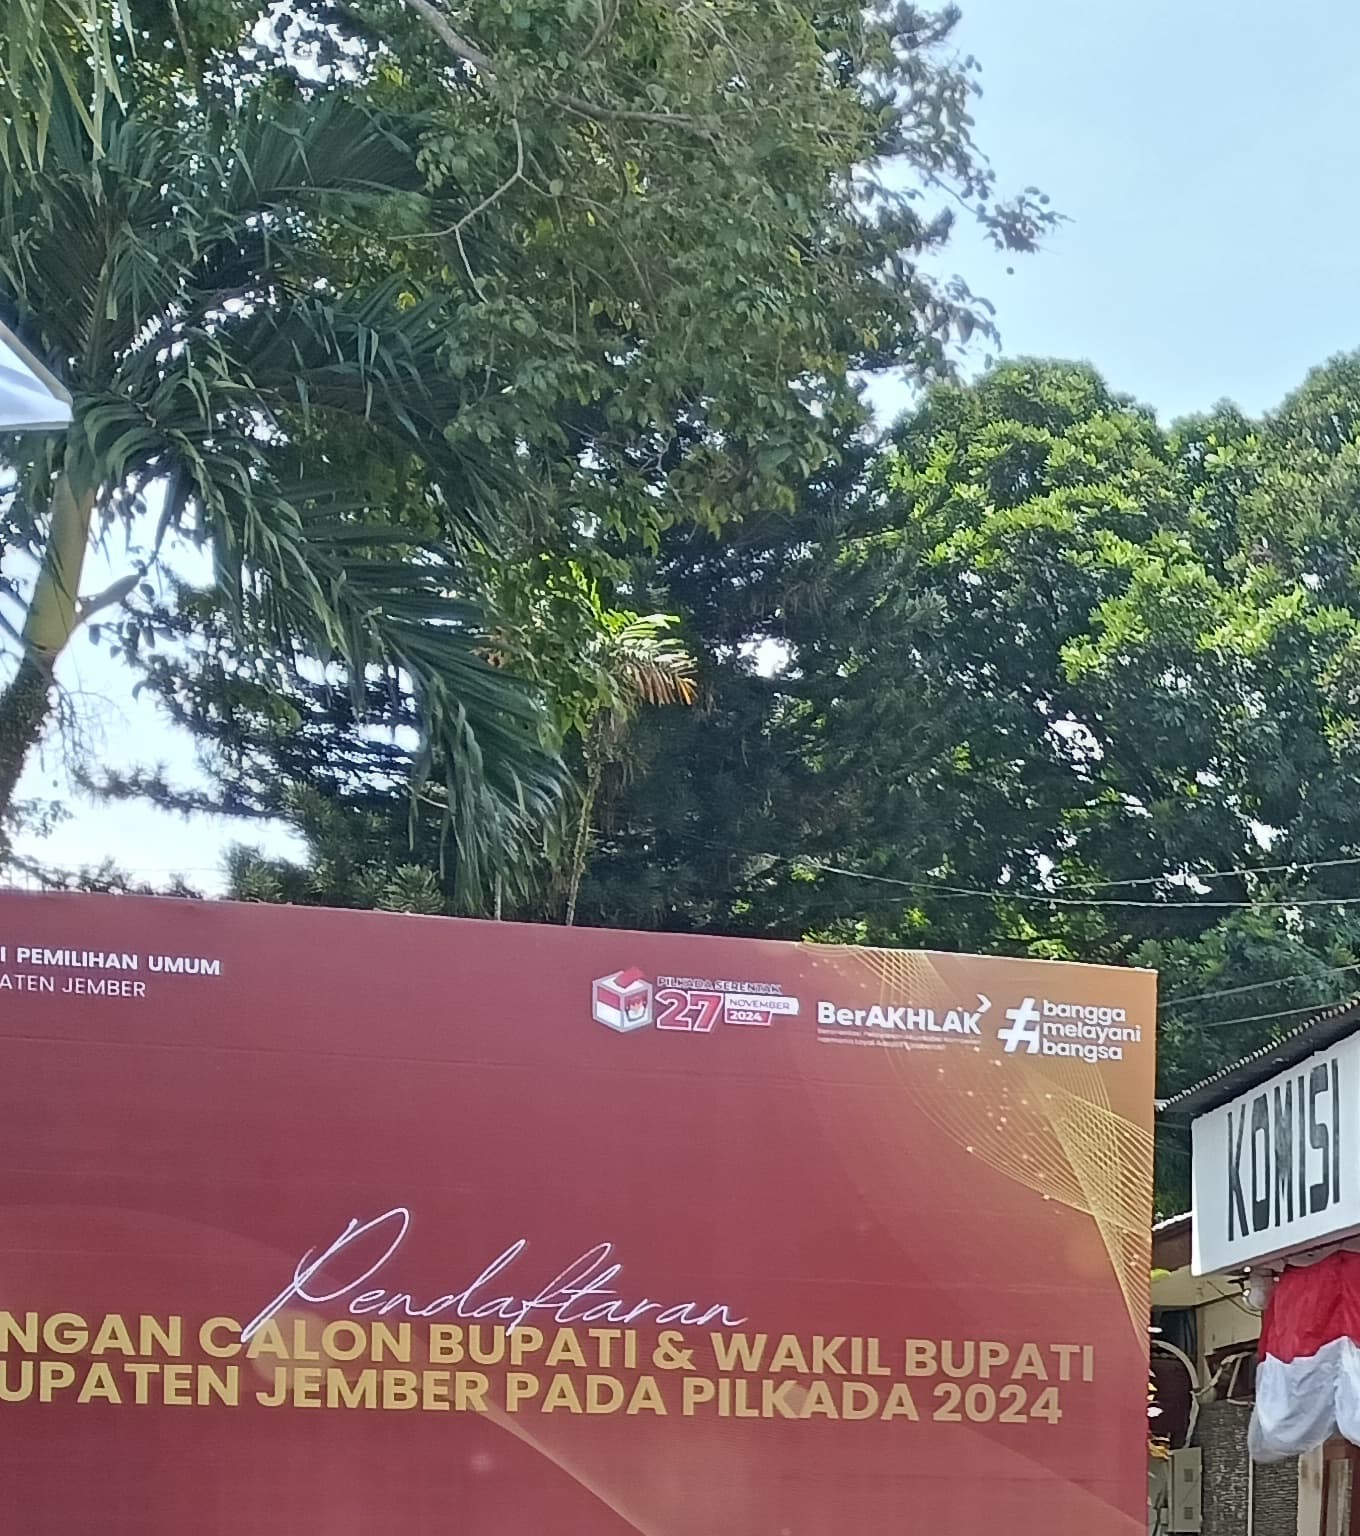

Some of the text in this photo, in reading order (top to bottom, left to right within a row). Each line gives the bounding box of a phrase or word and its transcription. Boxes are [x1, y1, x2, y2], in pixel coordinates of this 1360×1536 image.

[16, 946, 139, 971] PEMILIHAN
[148, 955, 221, 976] UMUM
[62, 978, 146, 998] JEMBER
[657, 976, 782, 995] PILKADA SERENTAK
[655, 989, 724, 1032] 27
[729, 997, 790, 1011] NOVEMBER
[729, 1010, 763, 1022] 2024
[817, 1001, 983, 1035] BerAKHLAK
[1043, 1000, 1126, 1025] bangga
[1042, 1022, 1142, 1044] melayani
[1042, 1038, 1123, 1064] bangsa
[1227, 1061, 1341, 1242] KOMISI
[241, 1208, 747, 1342] Pendaftaran
[0, 1311, 1094, 1382] NGAN CALON BUPATI & WAKIL BUPATI
[255, 1366, 489, 1412] JEMBER
[506, 1373, 667, 1416] PADA
[682, 1378, 919, 1422] PILKADA
[932, 1384, 1063, 1425] 2024
